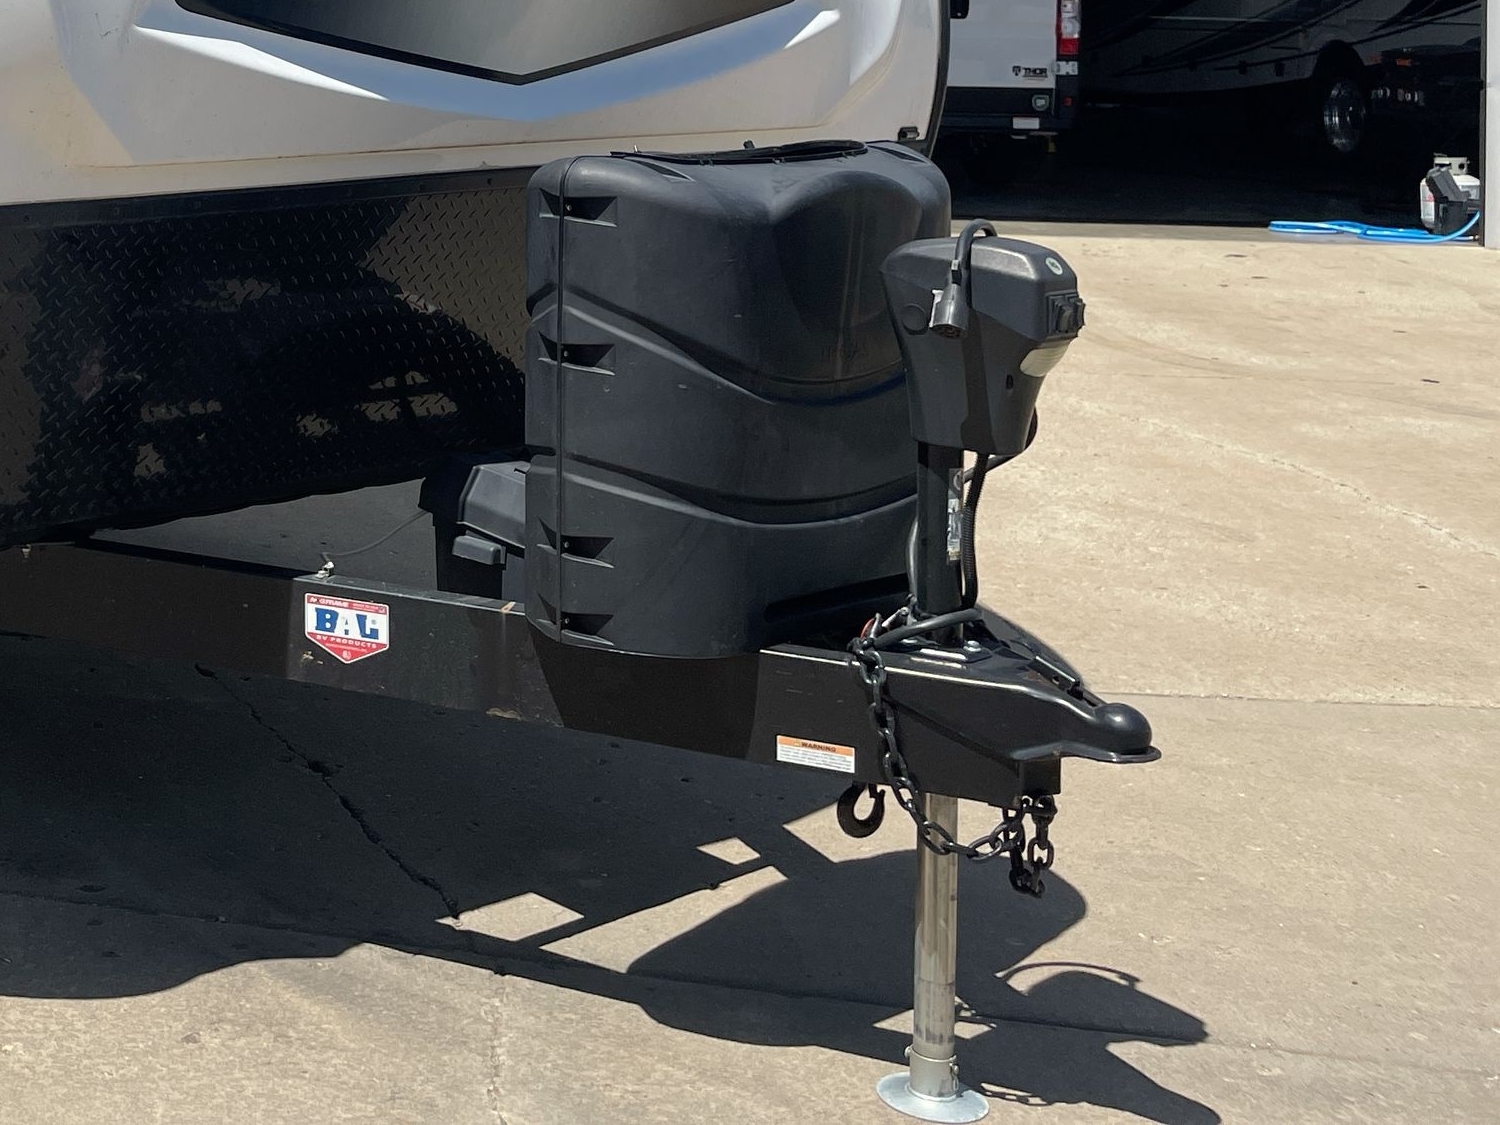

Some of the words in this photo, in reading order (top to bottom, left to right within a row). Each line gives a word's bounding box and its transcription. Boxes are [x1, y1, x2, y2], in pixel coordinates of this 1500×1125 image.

[315, 607, 379, 640] BAL
[330, 637, 377, 649] PRODUCTS
[801, 742, 837, 753] WARNING
